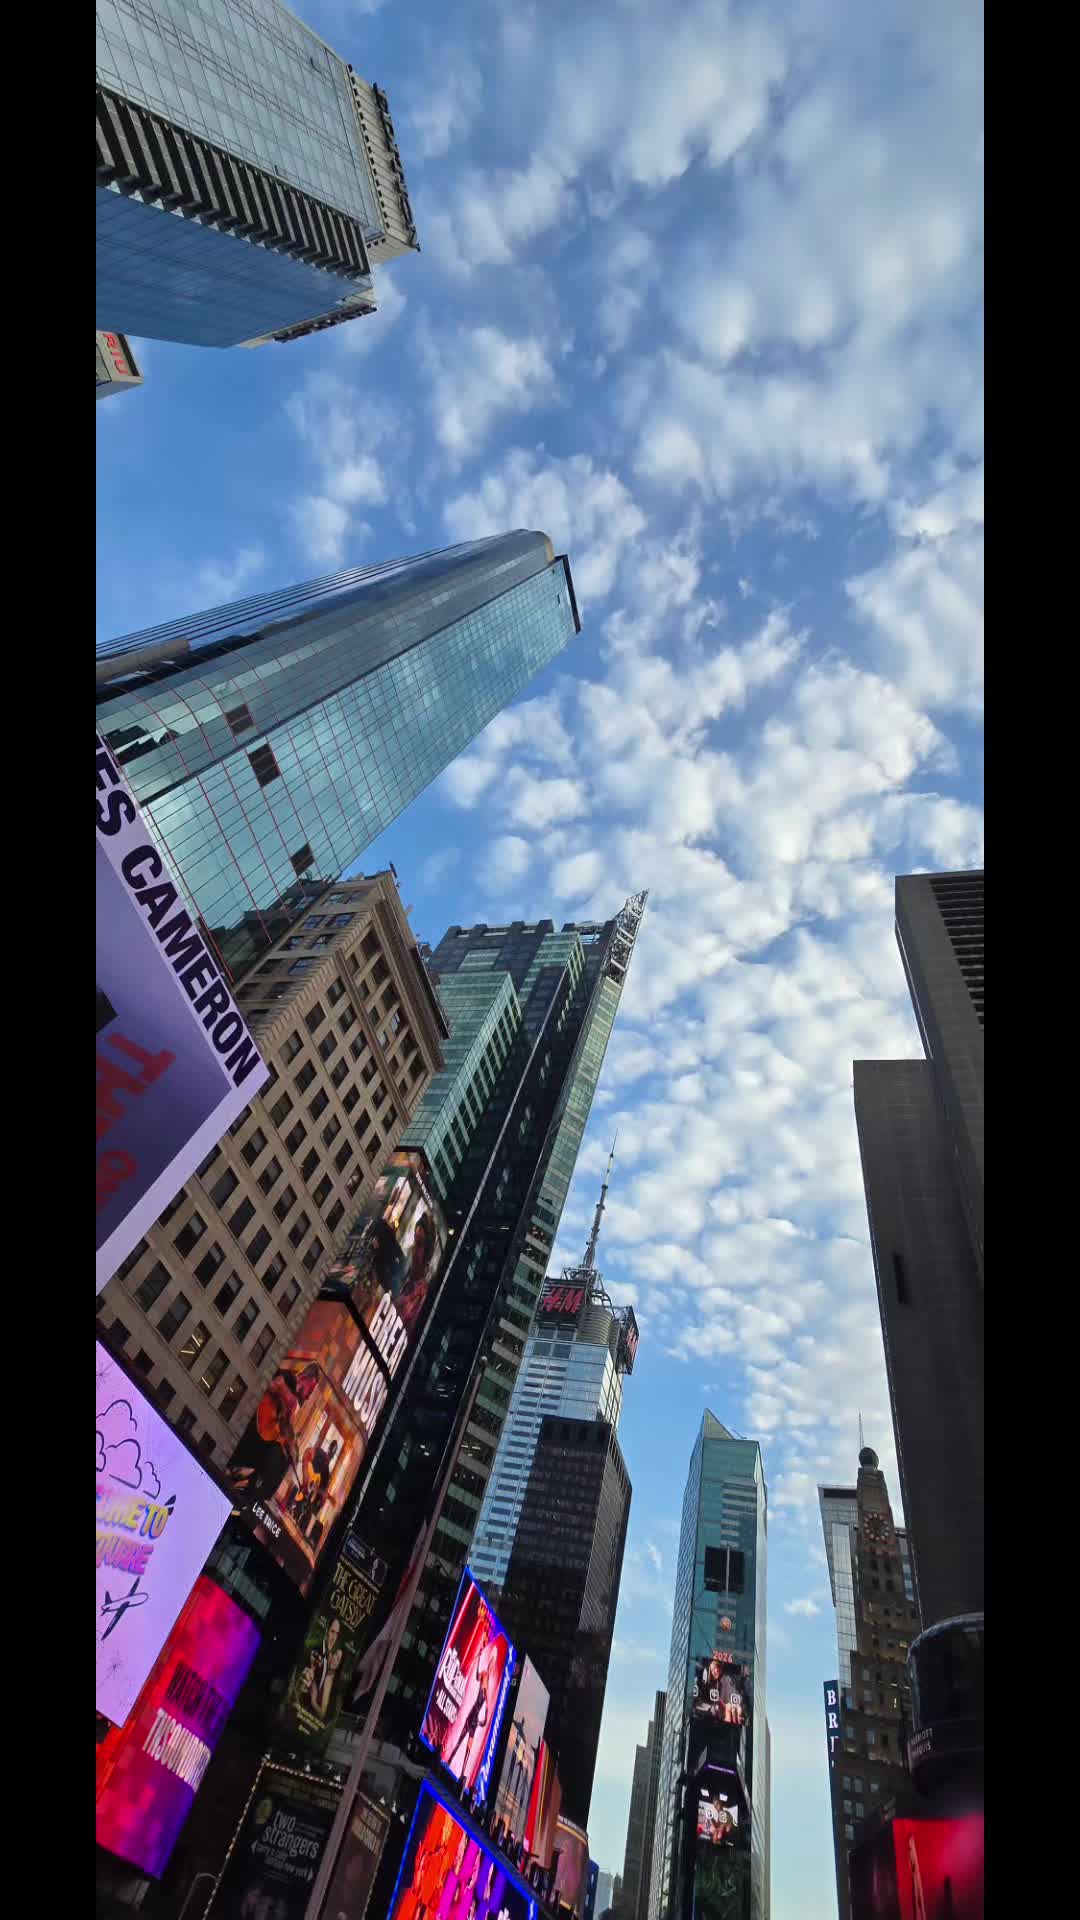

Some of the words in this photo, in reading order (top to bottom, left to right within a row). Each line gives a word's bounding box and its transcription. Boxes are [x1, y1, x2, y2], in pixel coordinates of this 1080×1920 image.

[121, 845, 261, 1088] CAMERON
[544, 1286, 585, 1313] H&M
[139, 1503, 169, 1540] TO
[251, 1502, 267, 1521] LEE
[273, 1810, 297, 1833] two
[262, 1825, 320, 1859] strangers
